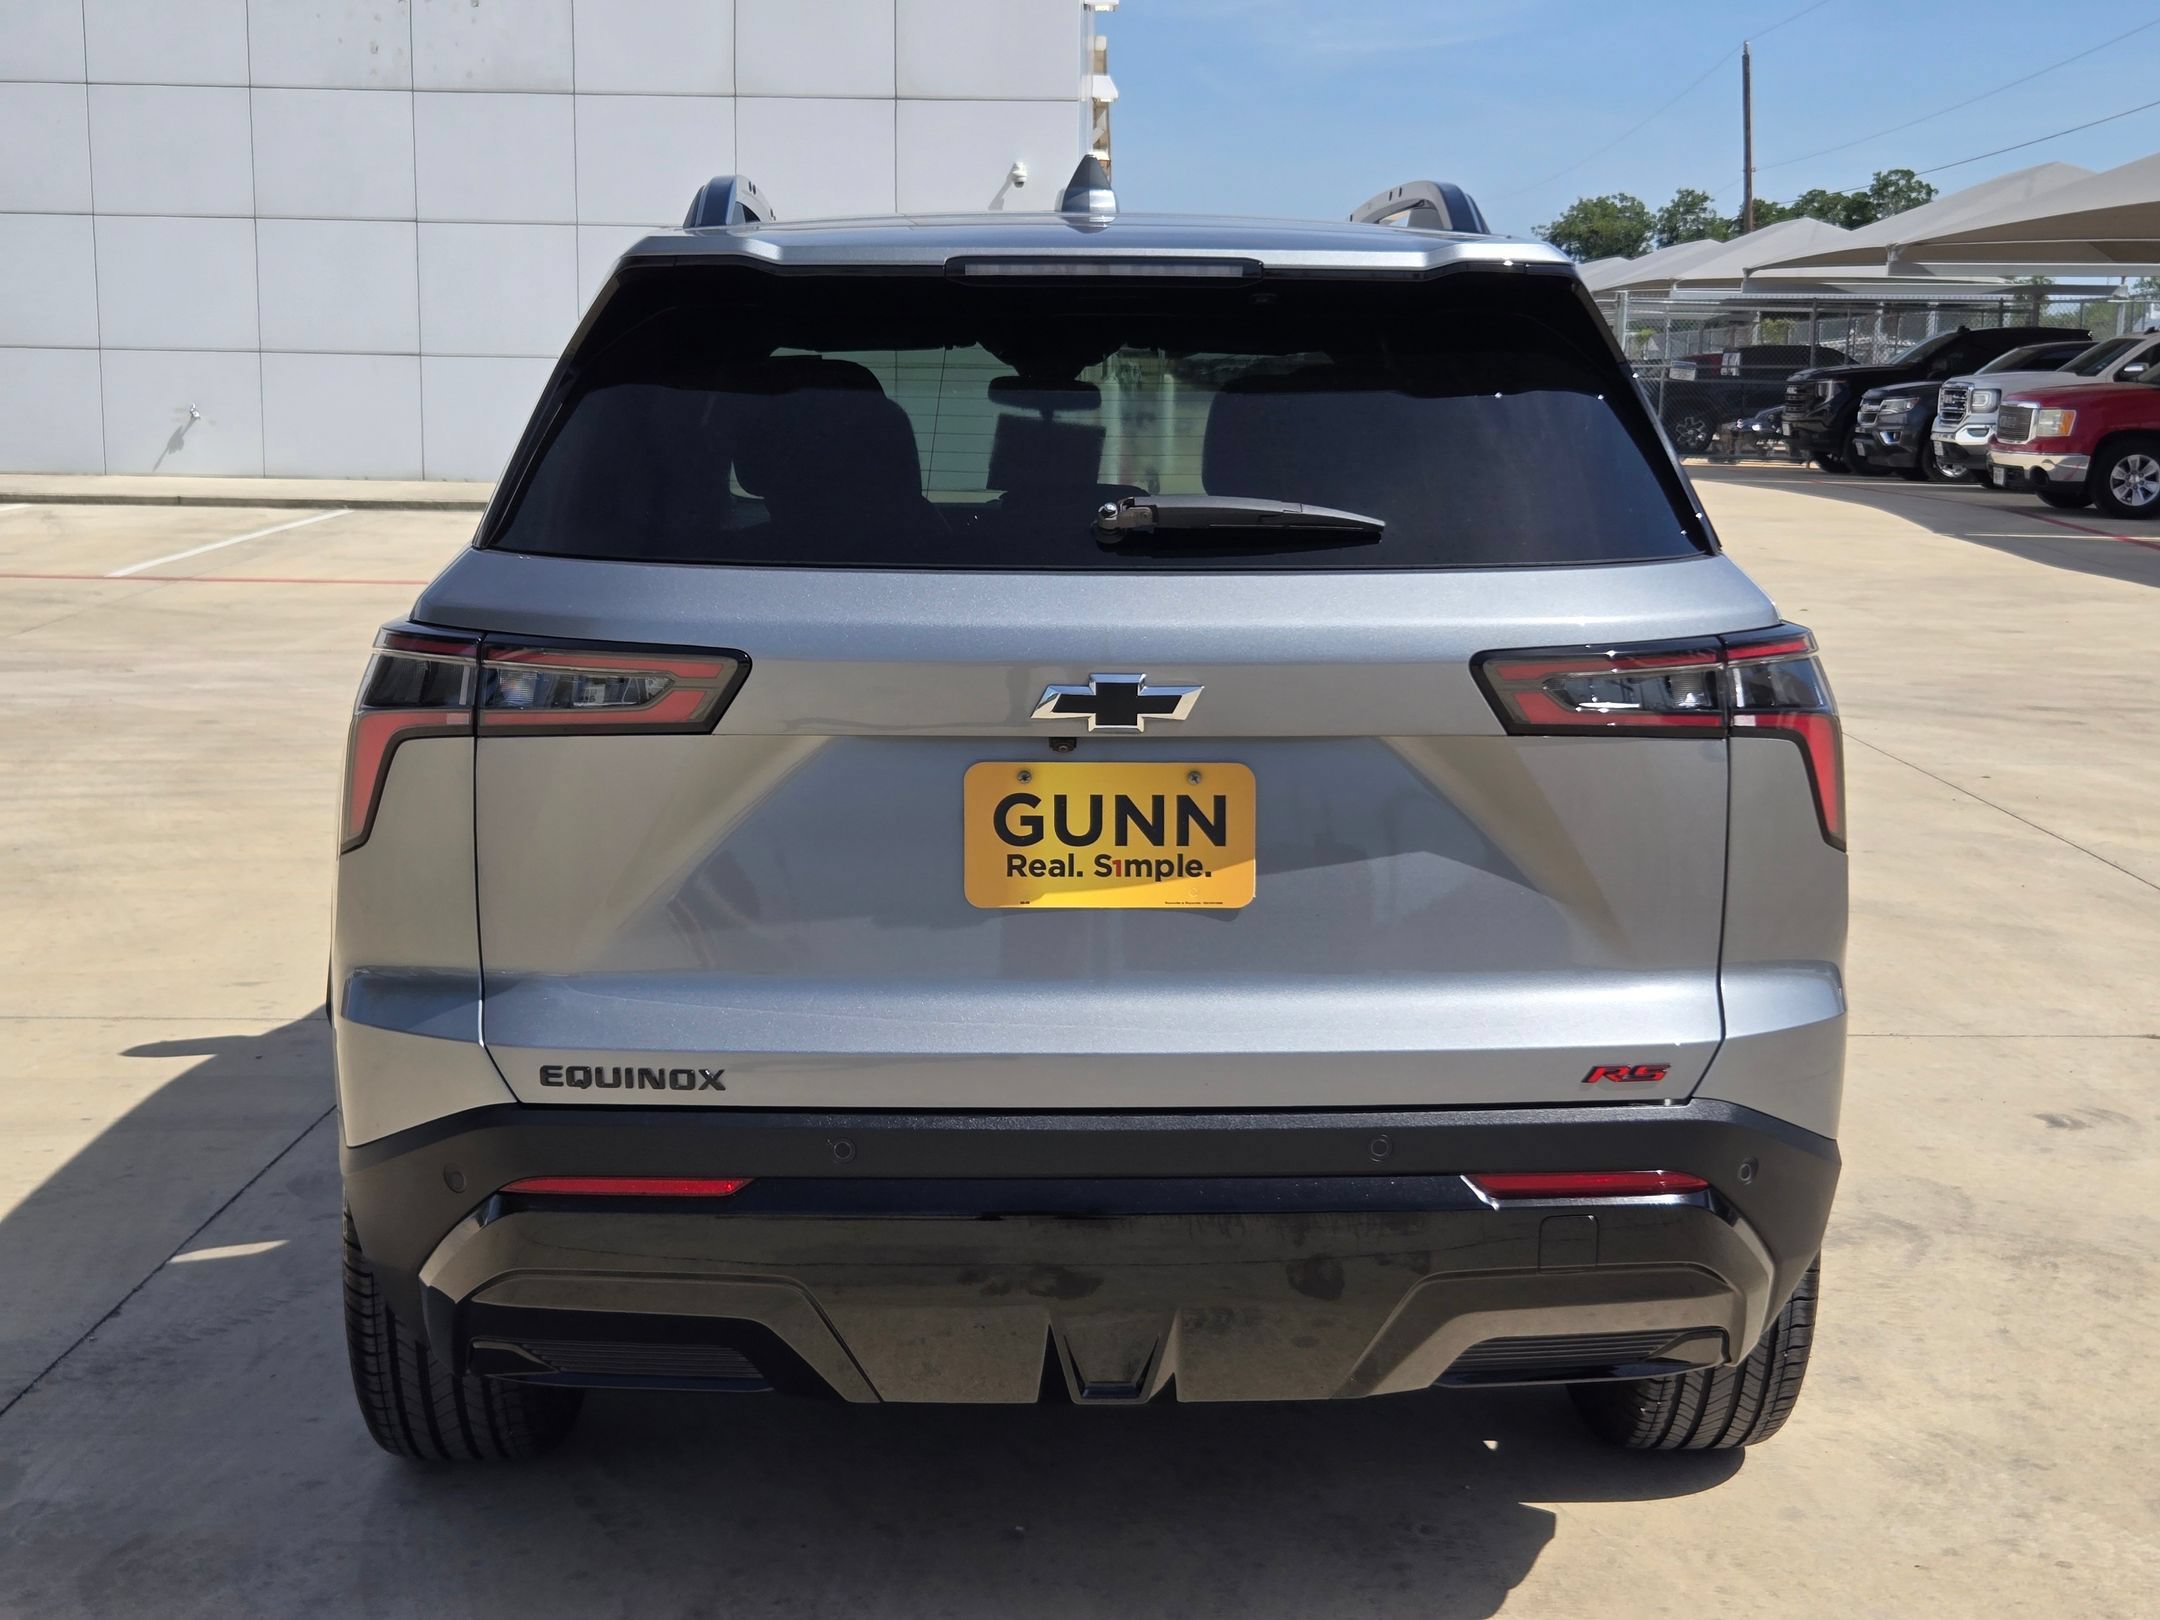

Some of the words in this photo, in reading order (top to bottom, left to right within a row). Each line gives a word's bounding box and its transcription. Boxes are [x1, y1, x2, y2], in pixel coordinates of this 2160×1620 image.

[993, 793, 1227, 847] GUNN
[1006, 853, 1083, 877] Real.
[539, 1064, 726, 1091] EQUINOX
[1580, 1064, 1671, 1083] RS
